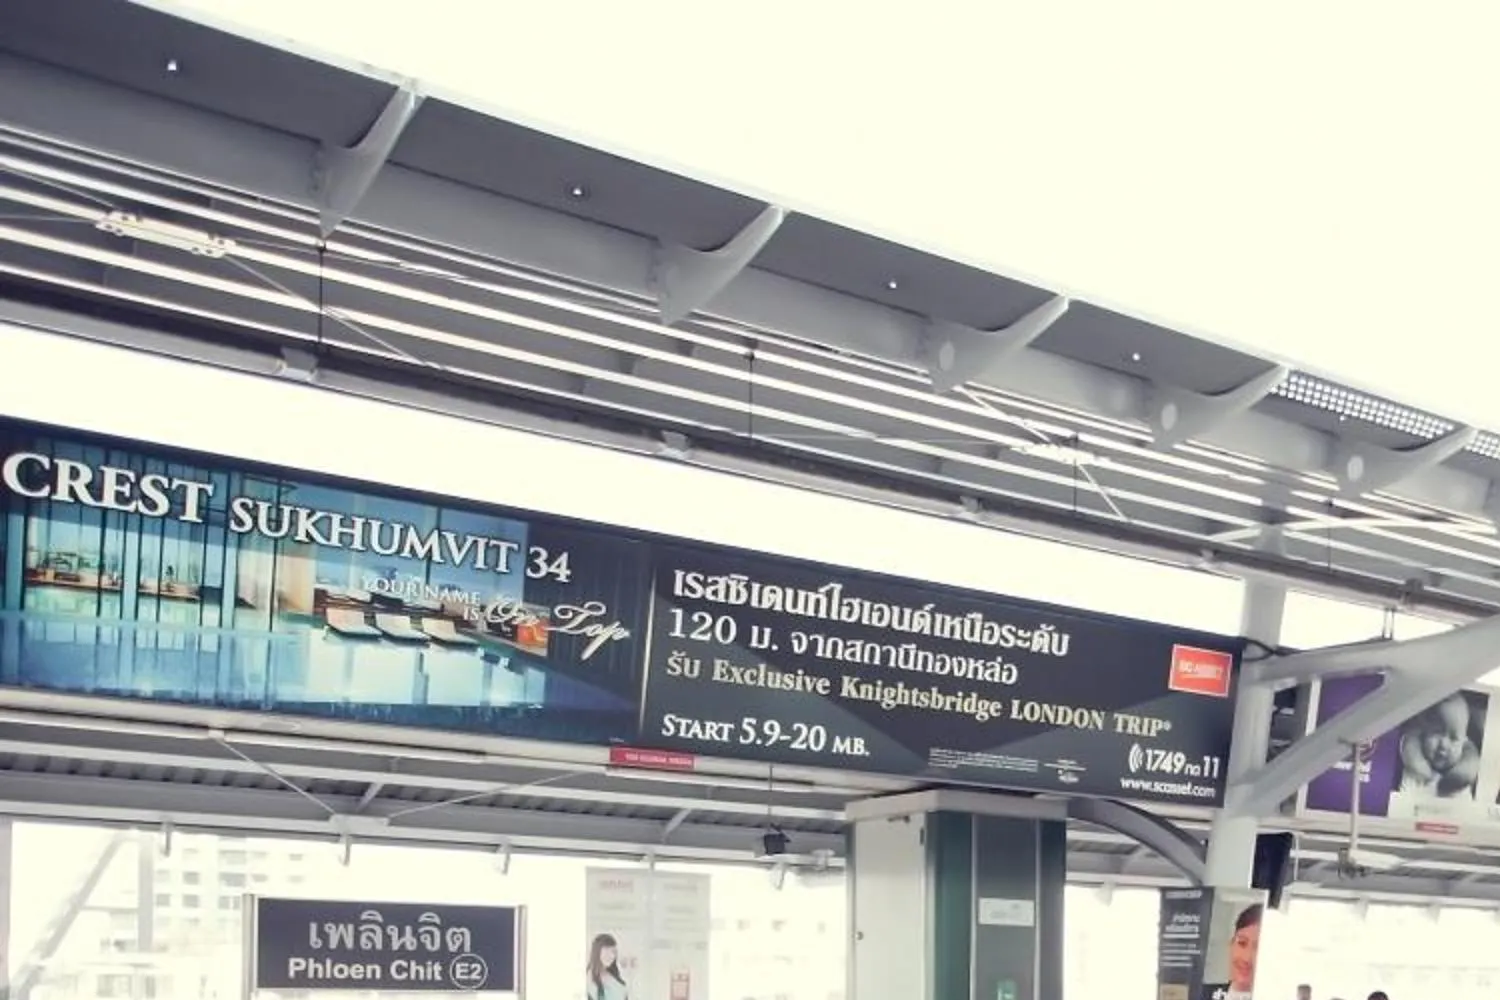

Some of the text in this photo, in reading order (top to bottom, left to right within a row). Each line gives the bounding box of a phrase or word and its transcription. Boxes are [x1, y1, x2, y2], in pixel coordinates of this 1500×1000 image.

[2, 452, 573, 583] CREST SUKHUMVIT 34
[424, 580, 481, 604] NAME
[543, 601, 631, 661] Top
[667, 608, 1019, 685] 120 ม. จากสถานีทองหล่อ
[666, 650, 701, 679] รับ
[711, 658, 831, 696] Exclusive
[840, 674, 1001, 722] Knightsbridge
[1010, 699, 1105, 731] LONDON
[661, 713, 871, 757] START 5.9-20 MB.
[1145, 748, 1186, 774] 1749
[1202, 755, 1220, 779] 11
[308, 909, 472, 952] เพลินจิต
[287, 956, 483, 981] Phloen Chit E2
